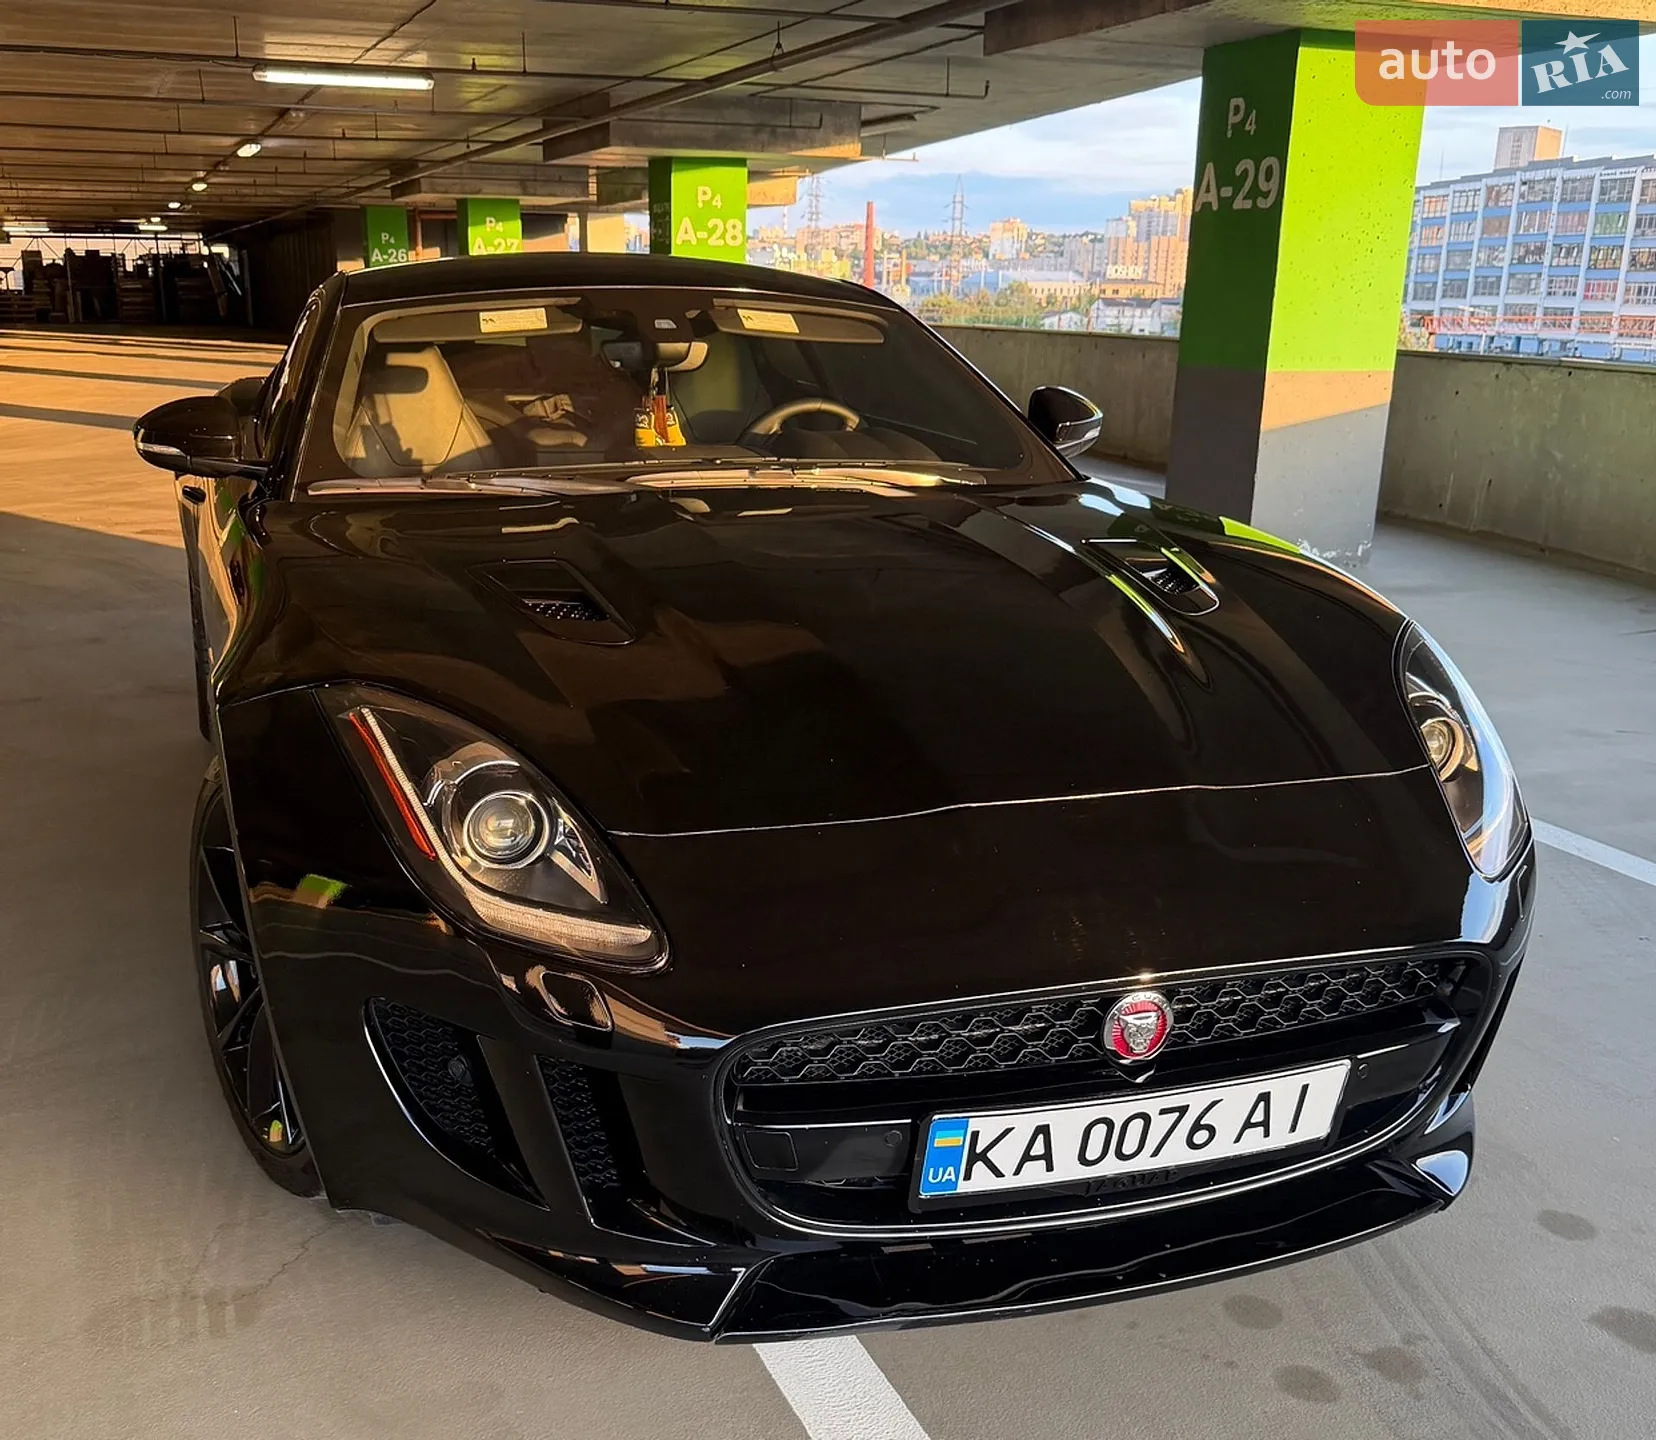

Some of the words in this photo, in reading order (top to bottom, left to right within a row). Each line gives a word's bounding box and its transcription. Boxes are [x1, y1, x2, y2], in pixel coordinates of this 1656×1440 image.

[1227, 97, 1257, 138] P4
[697, 186, 722, 208] P4
[1195, 156, 1280, 212] A-29
[676, 216, 743, 247] A-28
[371, 248, 407, 263] A-26
[963, 1123, 1054, 1181] KA
[1077, 1099, 1224, 1168] 0076
[1233, 1083, 1310, 1144] AI
[928, 1166, 956, 1184] UA
